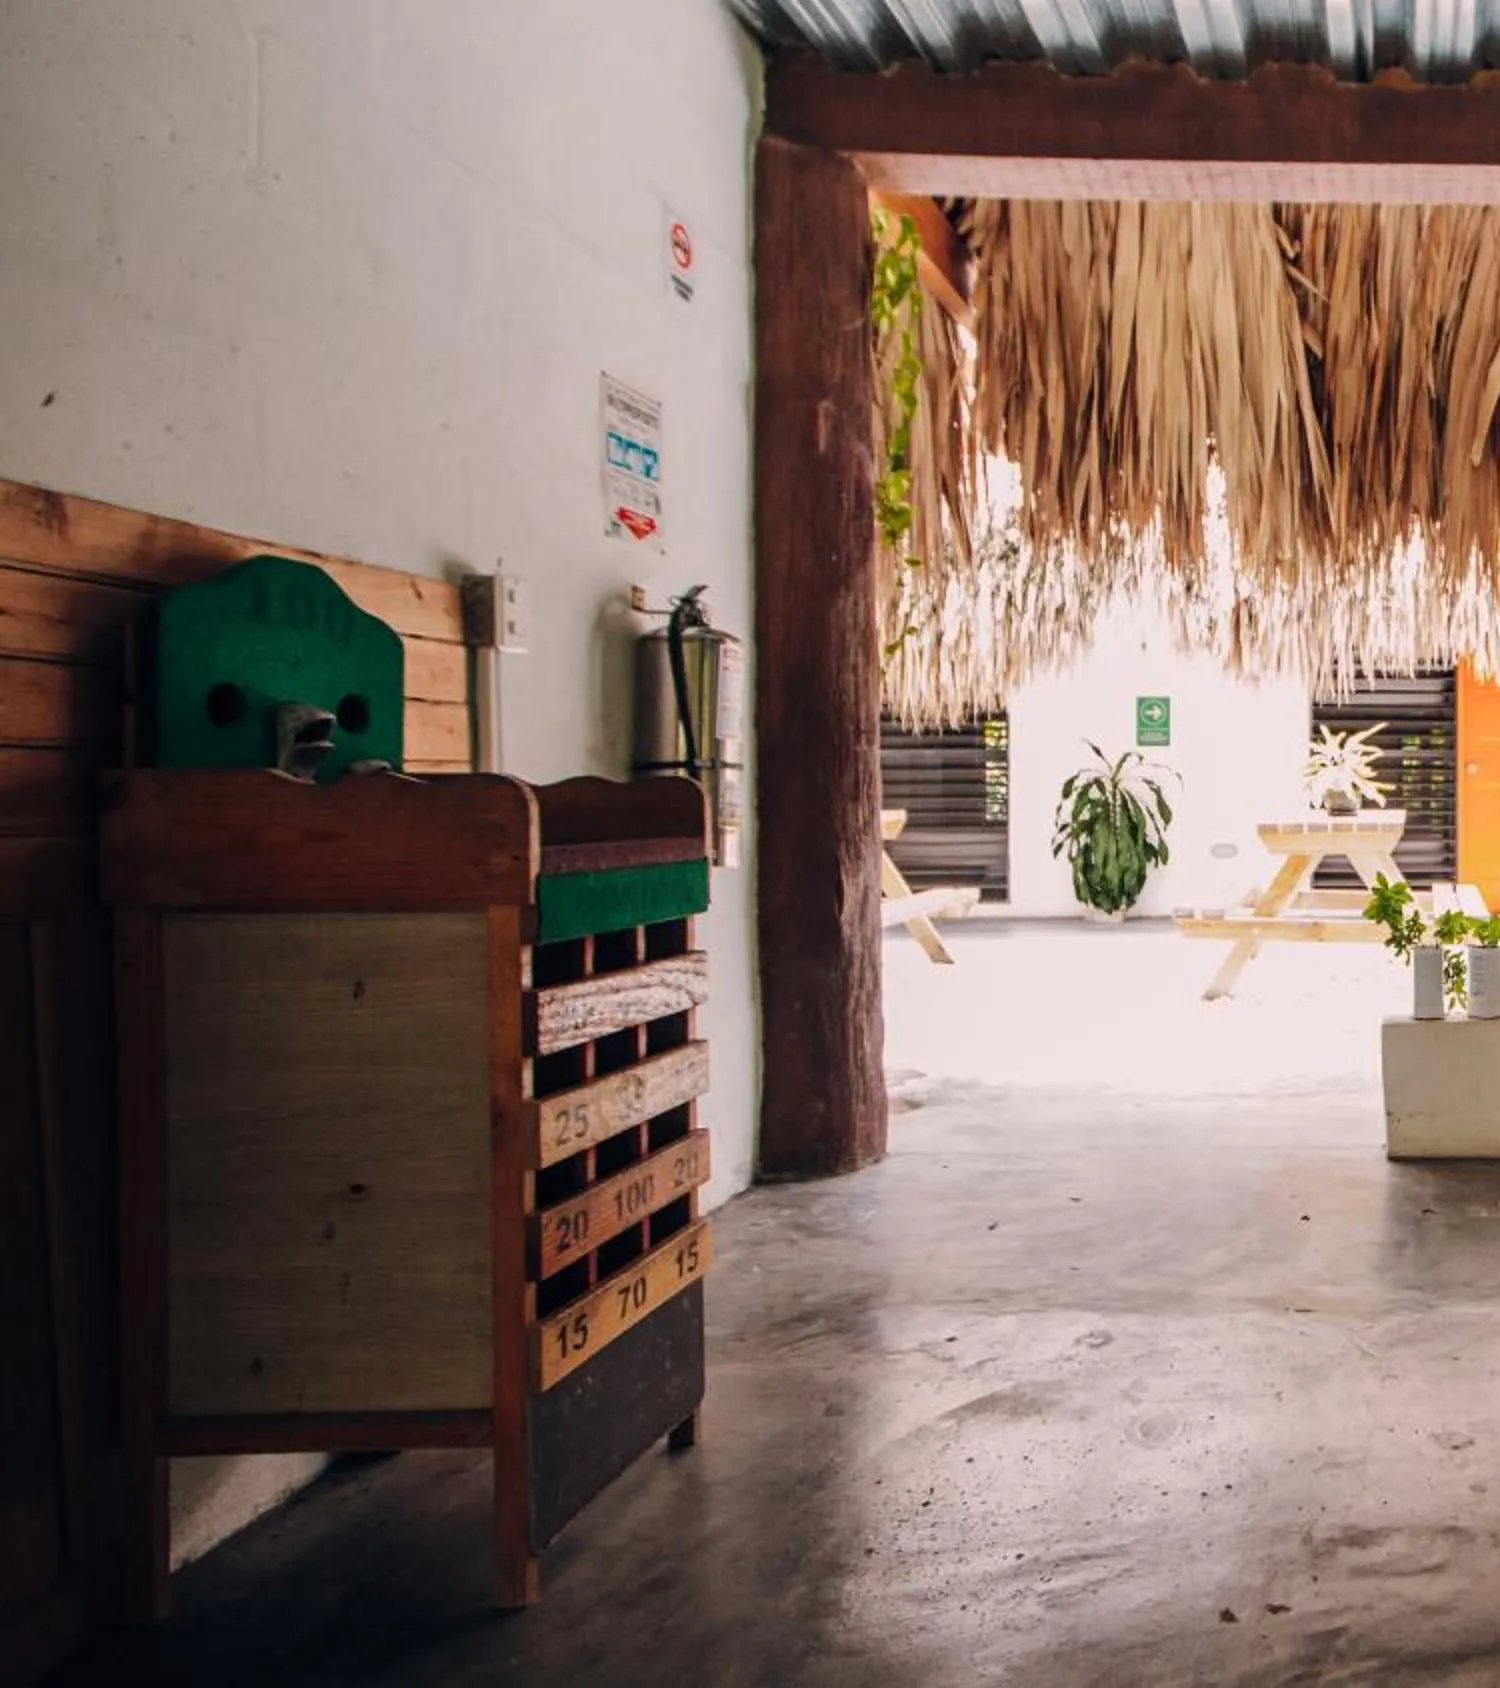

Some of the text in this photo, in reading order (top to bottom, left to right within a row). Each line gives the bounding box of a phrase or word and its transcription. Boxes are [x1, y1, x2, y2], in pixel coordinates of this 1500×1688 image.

[554, 1104, 589, 1147] 25
[554, 1150, 700, 1255] 20 100 20
[556, 1240, 700, 1359] 15 70 15
